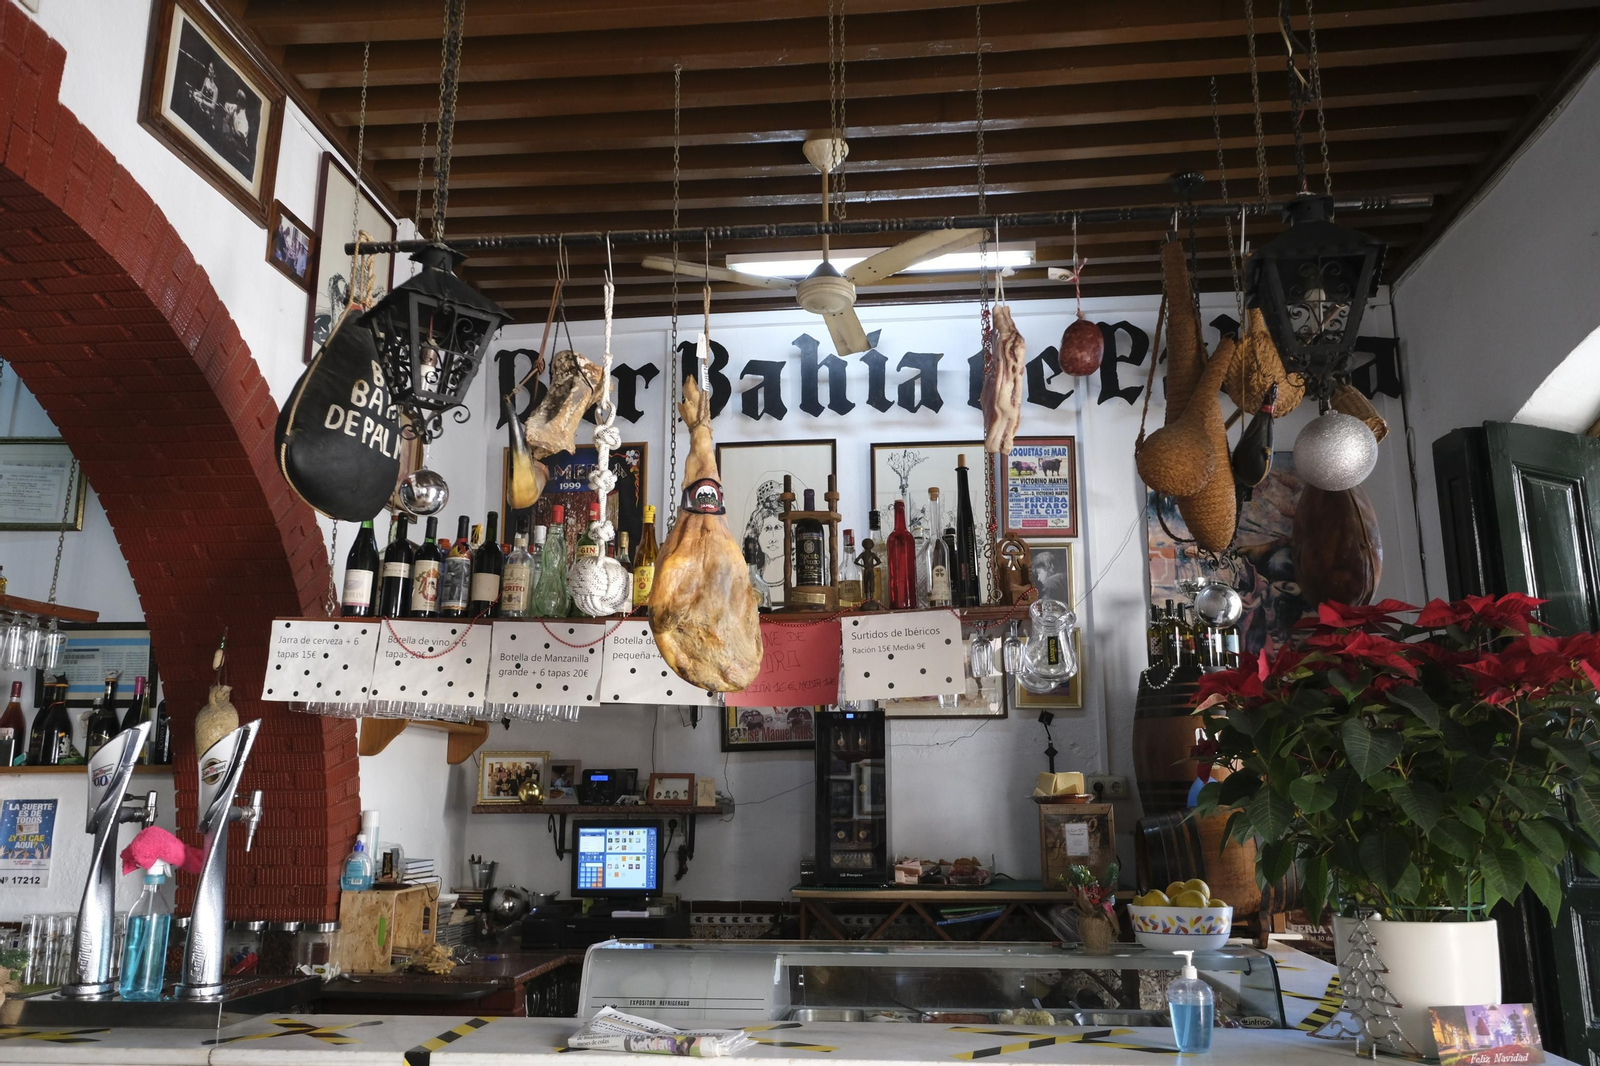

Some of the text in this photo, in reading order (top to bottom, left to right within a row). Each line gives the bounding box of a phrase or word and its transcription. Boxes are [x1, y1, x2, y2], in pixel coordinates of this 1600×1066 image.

[494, 348, 660, 430] Br
[324, 403, 362, 437] DE
[1051, 447, 1067, 456] MAR
[786, 632, 806, 642] DE
[852, 627, 940, 640] Surtidos de Ibéricos
[278, 636, 298, 644] Jarra
[300, 636, 310, 644] de
[388, 636, 416, 645] Botella
[418, 637, 430, 645] de
[432, 638, 450, 646] vino
[461, 639, 467, 647] 6
[614, 636, 643, 644] Botella
[277, 650, 299, 659] tapas
[385, 650, 408, 659] tapas
[500, 653, 589, 663] Botella de Manzanilla
[498, 668, 528, 677] grande
[548, 669, 570, 678] tapas
[573, 669, 589, 677] 20€
[12, 876, 40, 885] 17212
[1290, 924, 1326, 934] FERIA
[1470, 1052, 1530, 1064] Feliz Navidad
